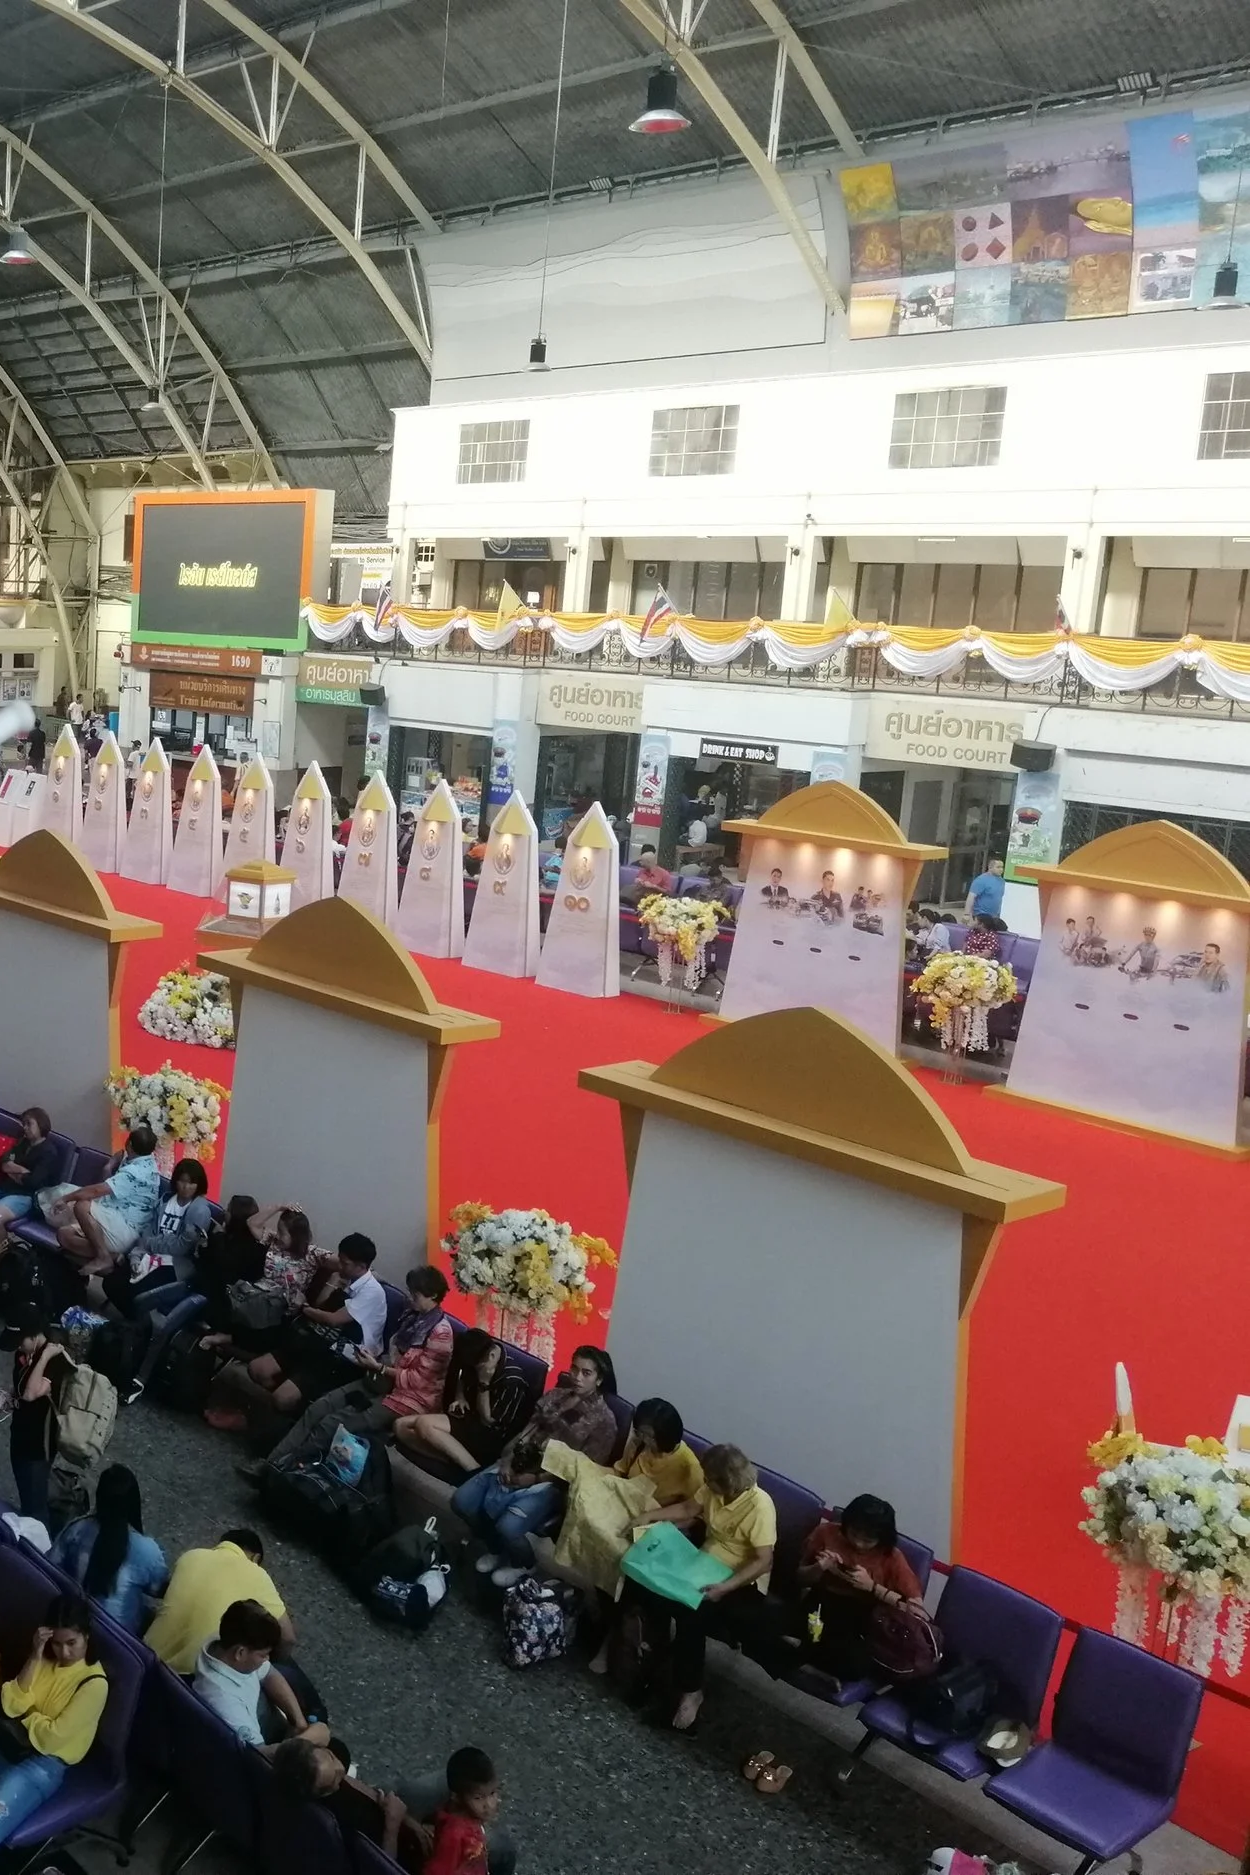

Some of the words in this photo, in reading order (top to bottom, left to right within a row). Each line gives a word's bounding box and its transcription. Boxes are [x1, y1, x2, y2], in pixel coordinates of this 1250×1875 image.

[231, 654, 251, 668] 1690
[306, 662, 369, 686] ศูนย์อาหา
[564, 711, 594, 723] FOOD
[597, 714, 636, 727] COURT
[884, 710, 1024, 743] ศูนย์อาหาร
[702, 743, 725, 757] DRINK
[730, 746, 744, 758] EAT
[745, 748, 765, 761] SHOP
[906, 743, 948, 759] FOOD
[952, 747, 1007, 764] COURT
